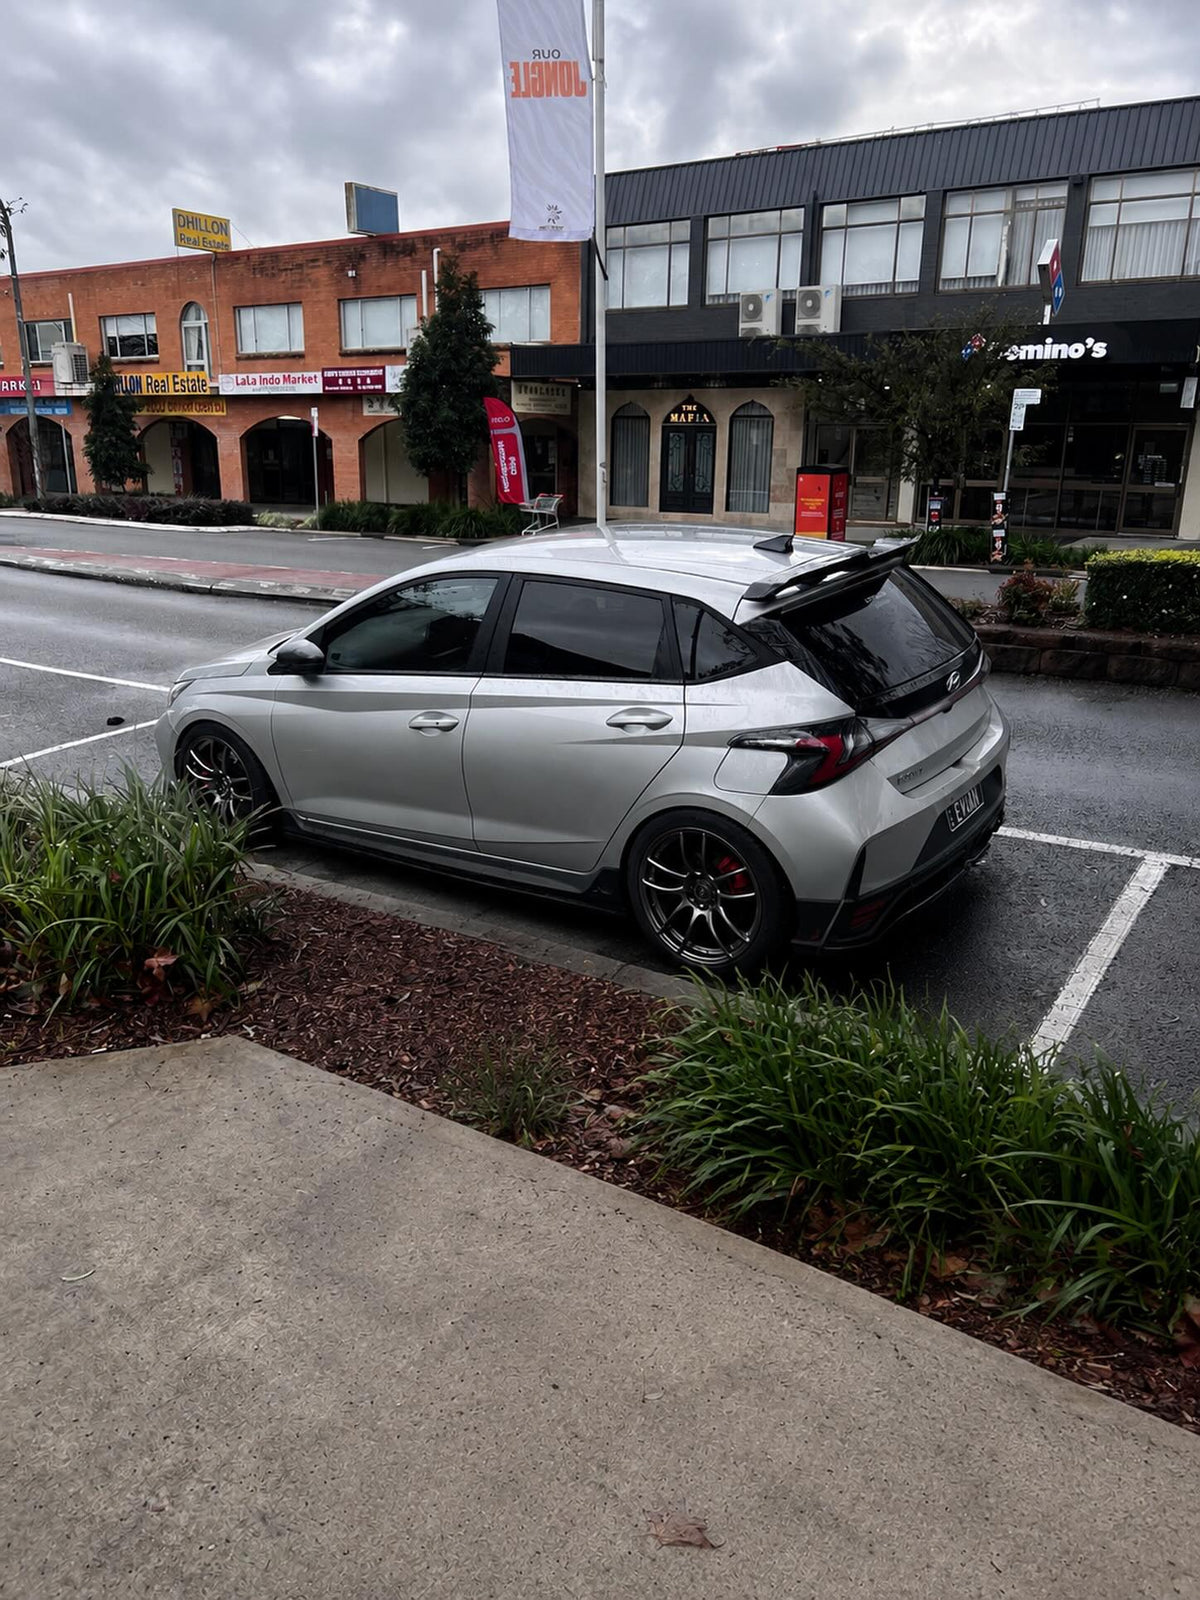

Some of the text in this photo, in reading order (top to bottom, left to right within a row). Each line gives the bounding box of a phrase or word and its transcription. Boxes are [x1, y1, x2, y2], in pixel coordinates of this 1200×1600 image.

[177, 214, 228, 236] DHILLON
[179, 233, 229, 250] Real Estate
[145, 374, 170, 394] Real
[172, 373, 208, 394] Estate
[235, 375, 257, 386] LaLa
[259, 375, 280, 386] Indo
[283, 373, 318, 385] Market
[670, 413, 710, 423] MAFIA
